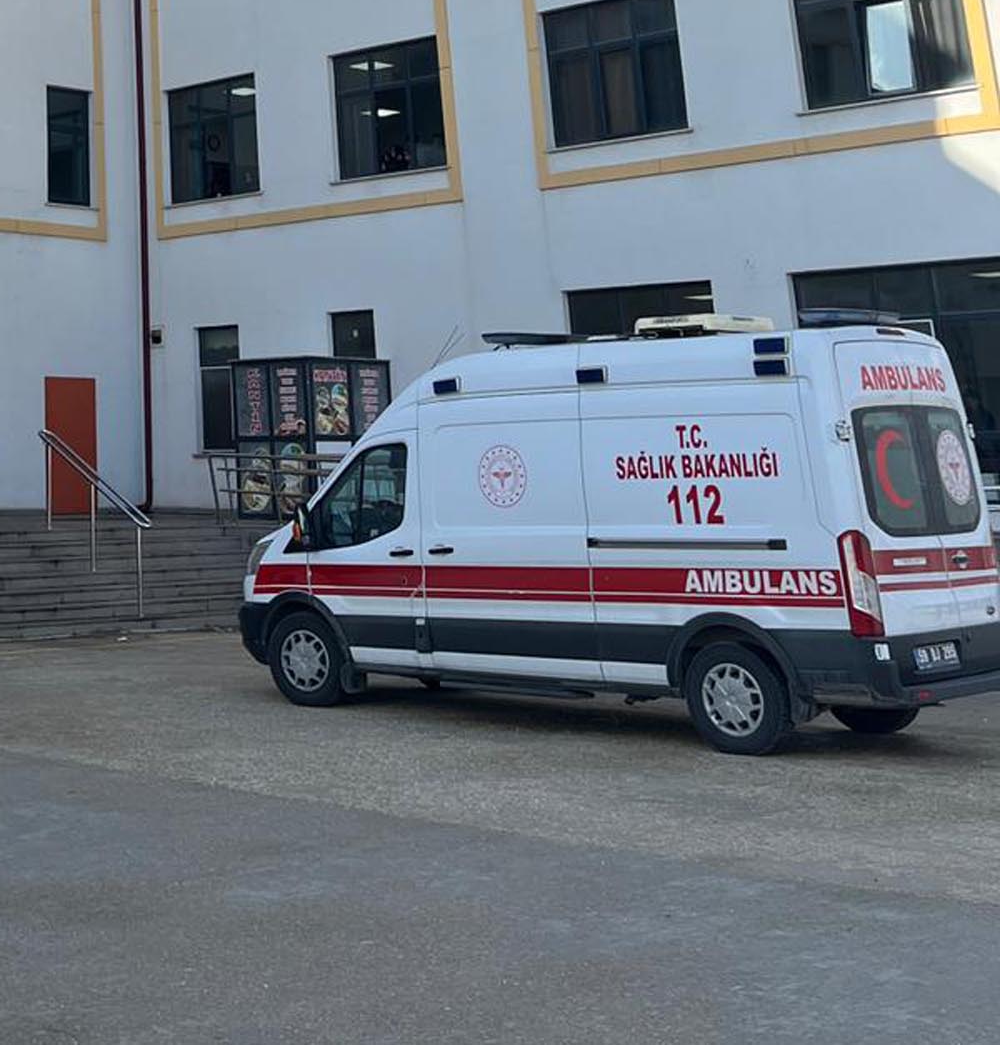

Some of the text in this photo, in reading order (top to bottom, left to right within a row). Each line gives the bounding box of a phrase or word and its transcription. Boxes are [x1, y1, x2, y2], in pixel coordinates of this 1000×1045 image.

[860, 365, 946, 392] AMBULANS
[675, 424, 708, 449] T.C.
[615, 447, 779, 479] SAĞLIK BAKANLIĞI
[667, 484, 725, 525] 112
[684, 569, 838, 596] AMBULANS
